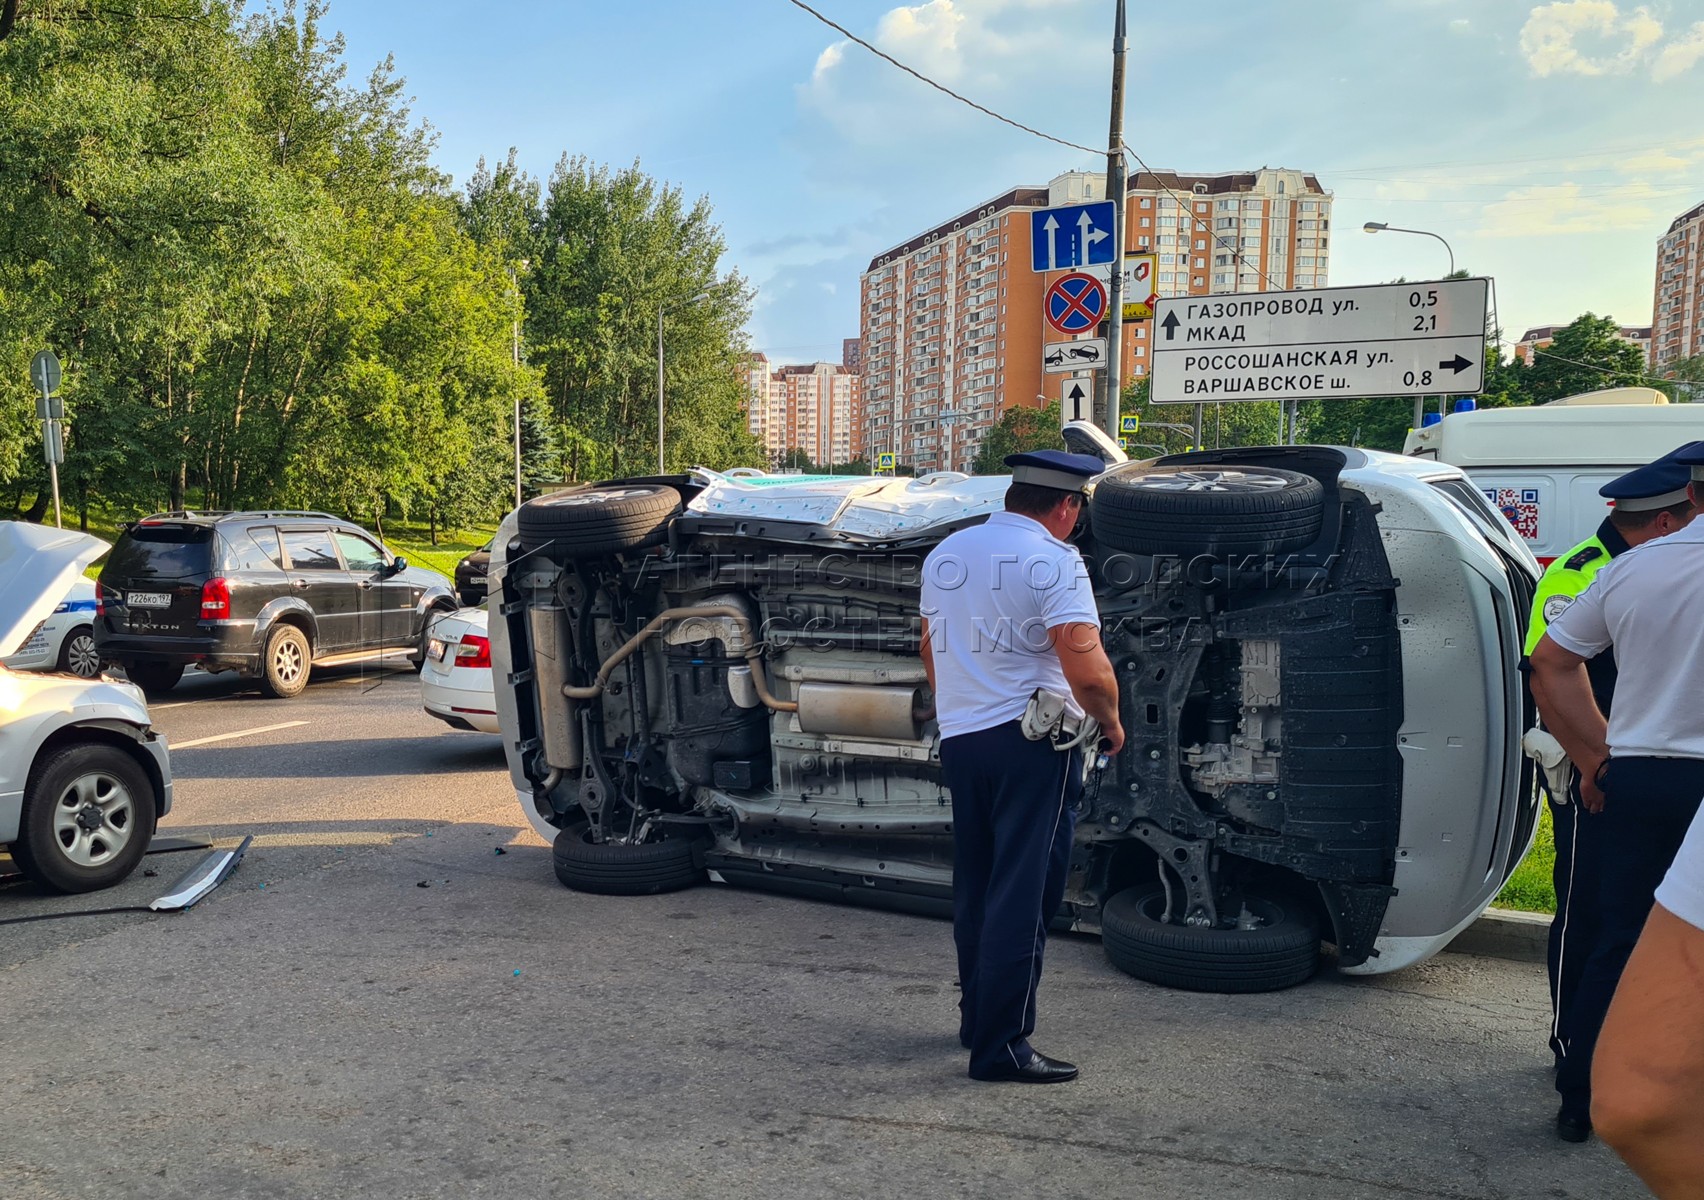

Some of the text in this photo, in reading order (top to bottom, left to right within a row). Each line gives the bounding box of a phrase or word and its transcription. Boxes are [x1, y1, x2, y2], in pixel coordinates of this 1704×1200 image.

[1187, 290, 1438, 319] ГАЗОПРОВОД ул. 0,5
[1186, 315, 1437, 342] МКАД 2,1
[1185, 350, 1394, 371] РОССОШАНСКАЯ ул.
[1184, 370, 1432, 394] ВАРШАВСКОЕ ш. 0,8
